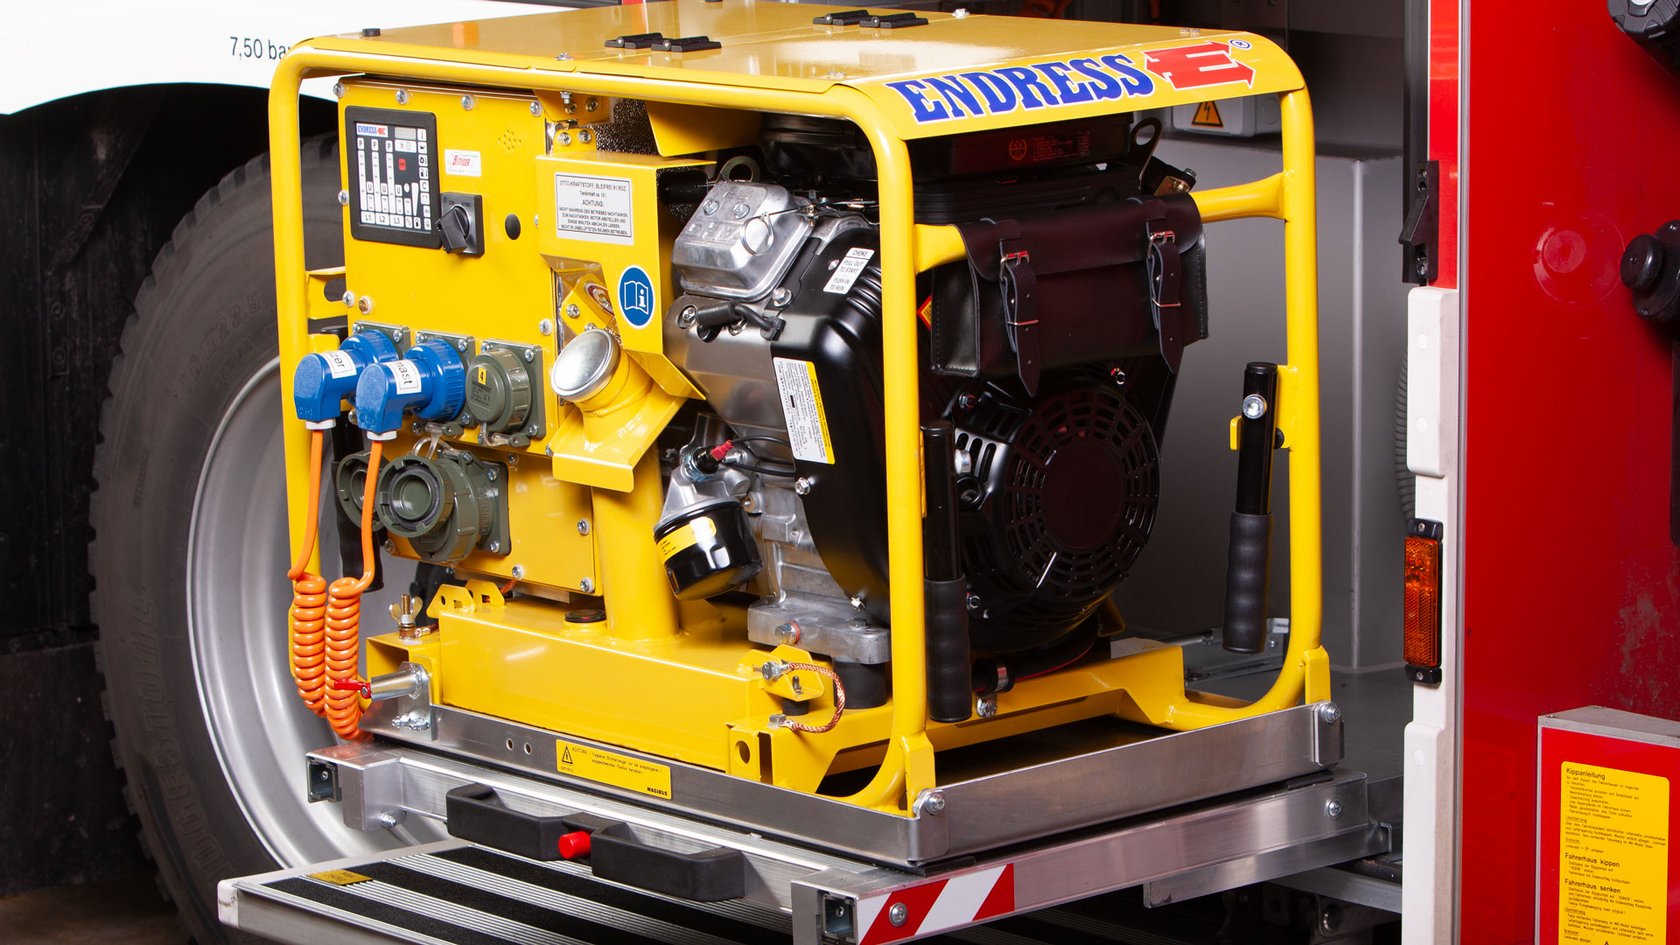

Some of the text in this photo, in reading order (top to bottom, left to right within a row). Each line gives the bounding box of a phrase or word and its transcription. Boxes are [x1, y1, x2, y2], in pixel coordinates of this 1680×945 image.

[230, 36, 291, 60] 7,50 ba
[885, 55, 1155, 124] ENDRESS
[1566, 768, 1606, 780] Kippanleitung
[647, 786, 668, 796] MAGIRUS
[1565, 852, 1597, 864] Fahrerhaus
[1600, 859, 1620, 868] kippen
[1565, 878, 1621, 894] Fahrerhaus senken
